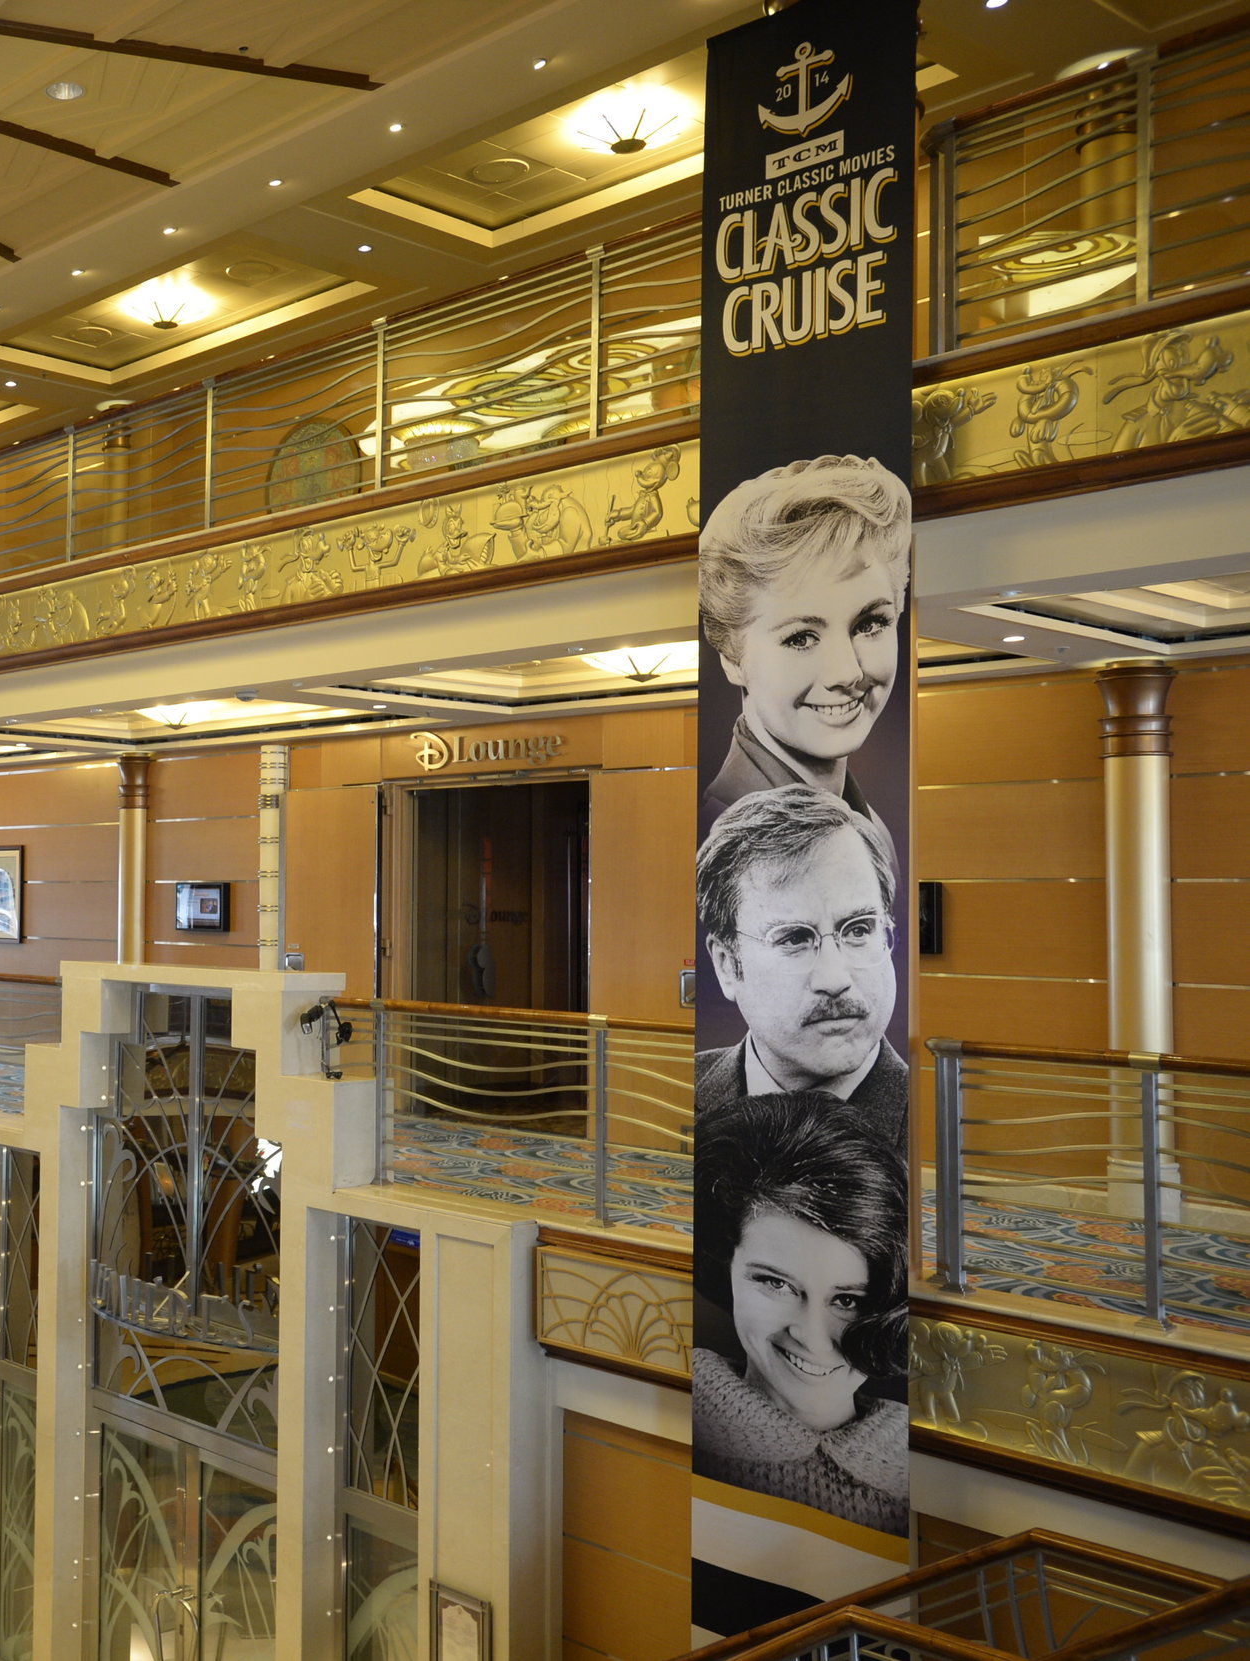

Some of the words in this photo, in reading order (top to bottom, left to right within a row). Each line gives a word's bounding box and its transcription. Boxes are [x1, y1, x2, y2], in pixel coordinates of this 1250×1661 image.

[775, 83, 792, 102] 20
[814, 70, 830, 87] 14
[719, 184, 773, 212] TURNER
[777, 164, 835, 197] CLASSIC
[839, 144, 895, 177] MOVIES
[772, 138, 839, 170] TCM
[716, 167, 897, 283] CLASSIC
[722, 251, 886, 356] CRUISE
[410, 731, 449, 771] D
[452, 734, 563, 766] Lounge
